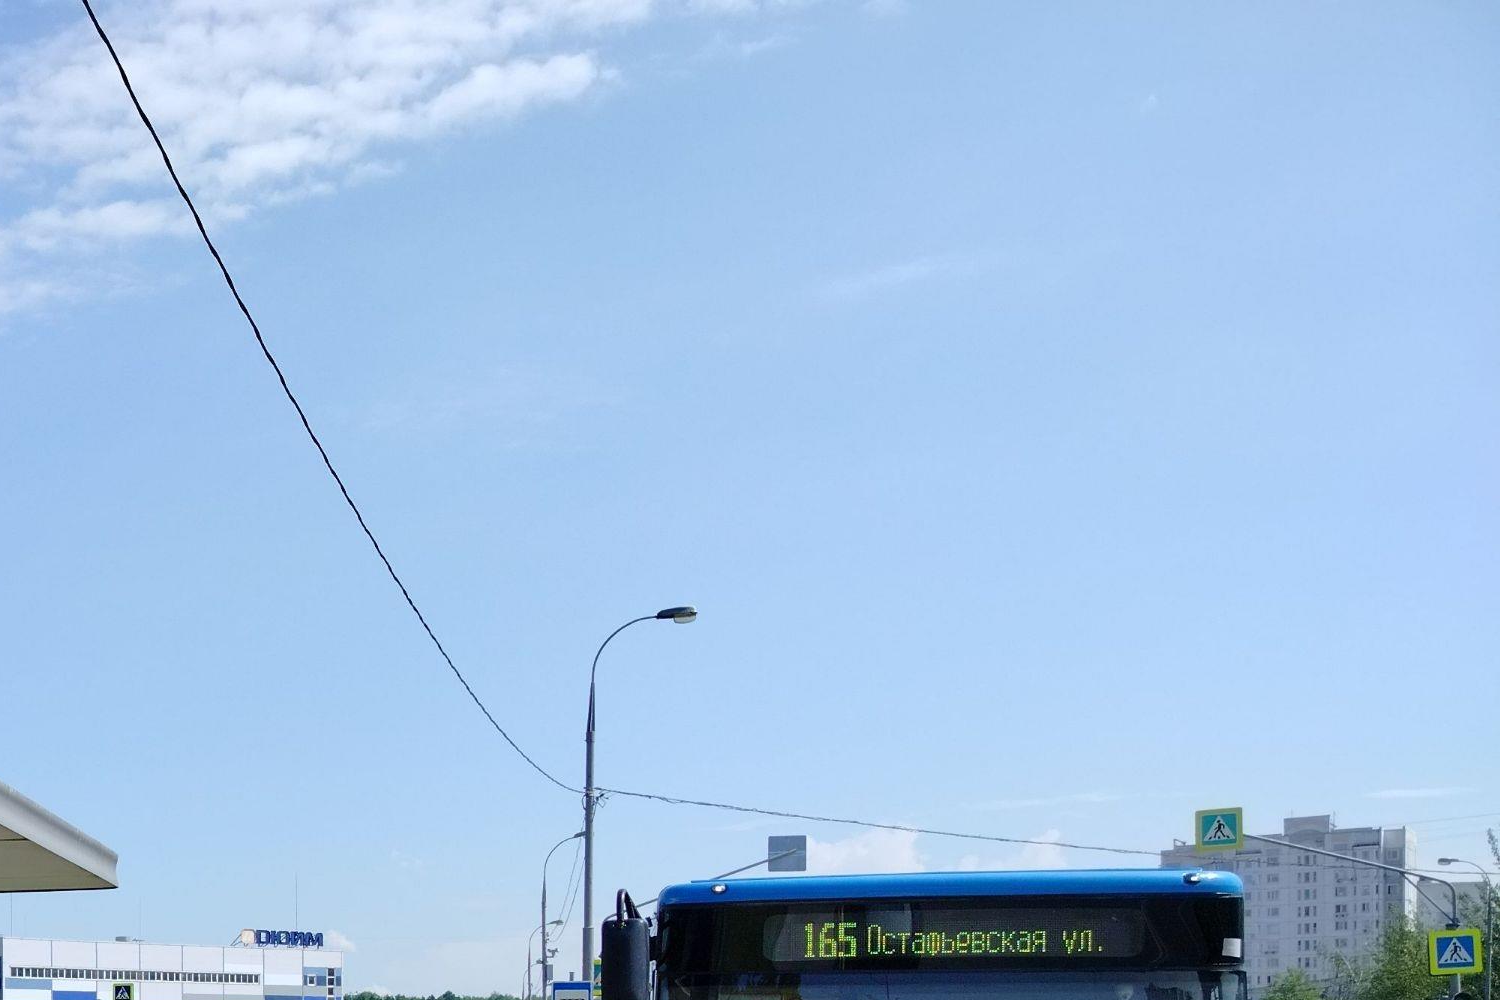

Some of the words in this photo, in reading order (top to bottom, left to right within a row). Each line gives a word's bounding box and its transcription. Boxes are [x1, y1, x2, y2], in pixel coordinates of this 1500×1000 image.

[804, 922, 857, 958] 165
[867, 924, 1047, 956] Остафьевская
[1062, 929, 1103, 954] ул.
